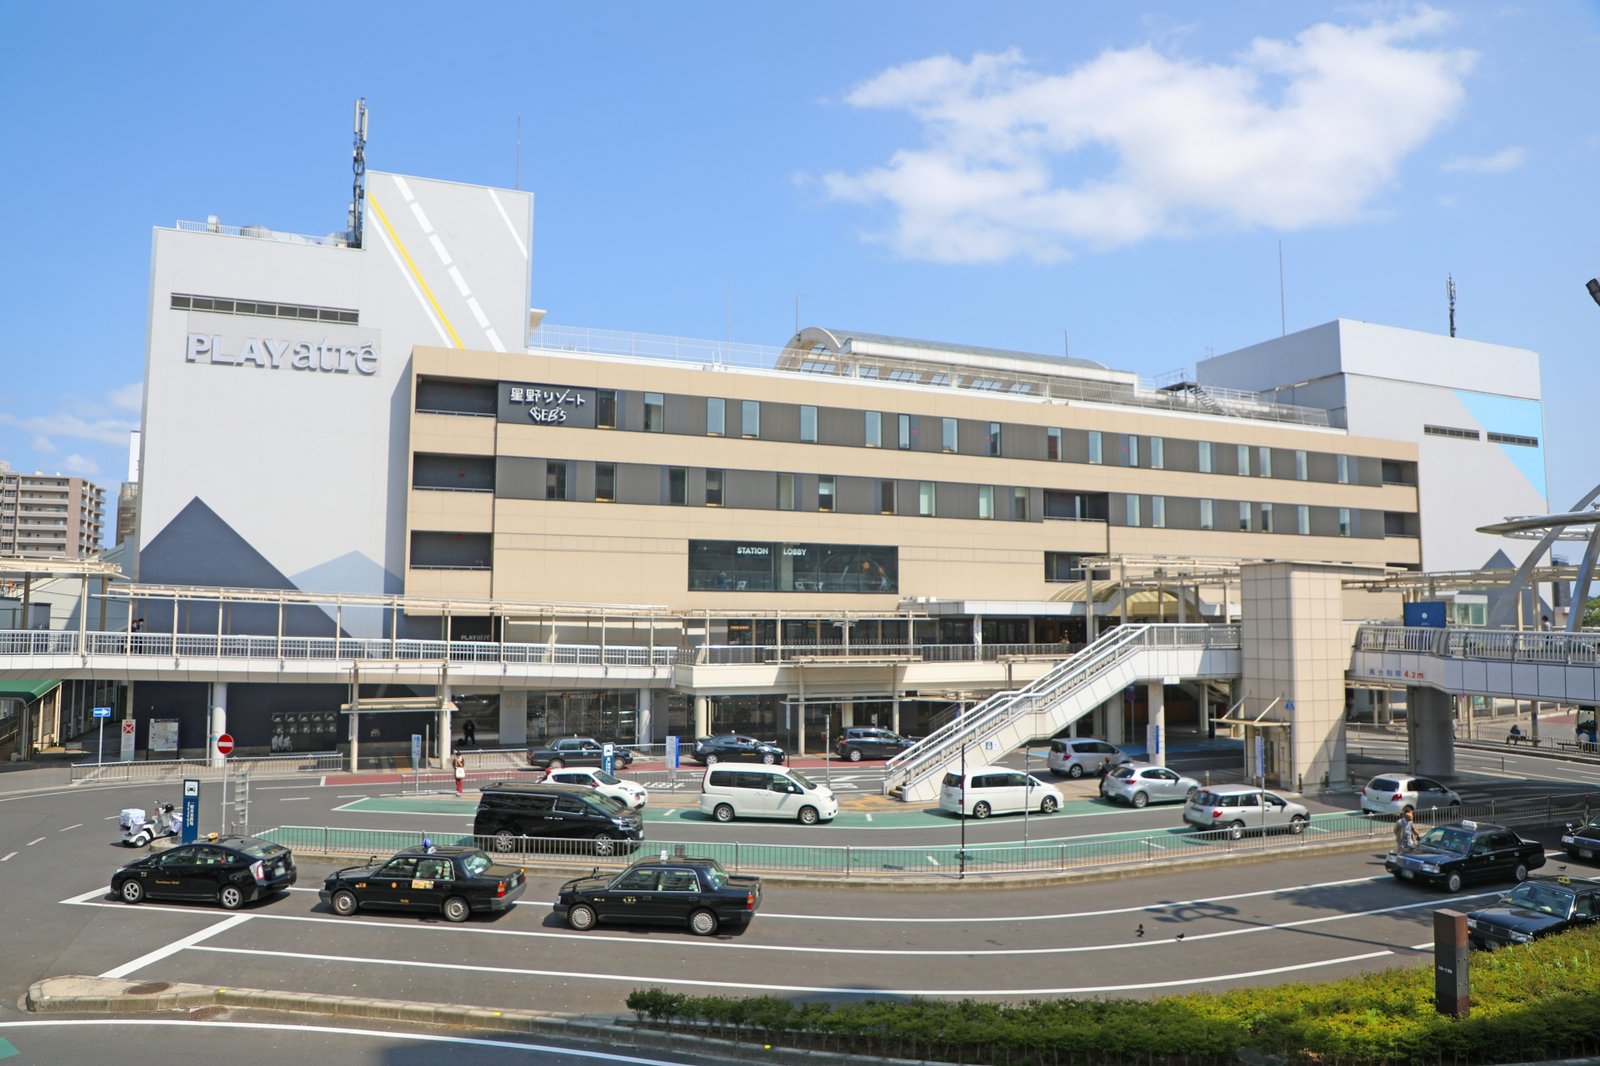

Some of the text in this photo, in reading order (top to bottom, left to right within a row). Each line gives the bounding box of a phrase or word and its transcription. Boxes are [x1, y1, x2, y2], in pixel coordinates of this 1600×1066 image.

[185, 332, 379, 376] PLAYatré
[509, 386, 586, 407] 星野リゾート
[737, 546, 806, 556] STATION LOBBY
